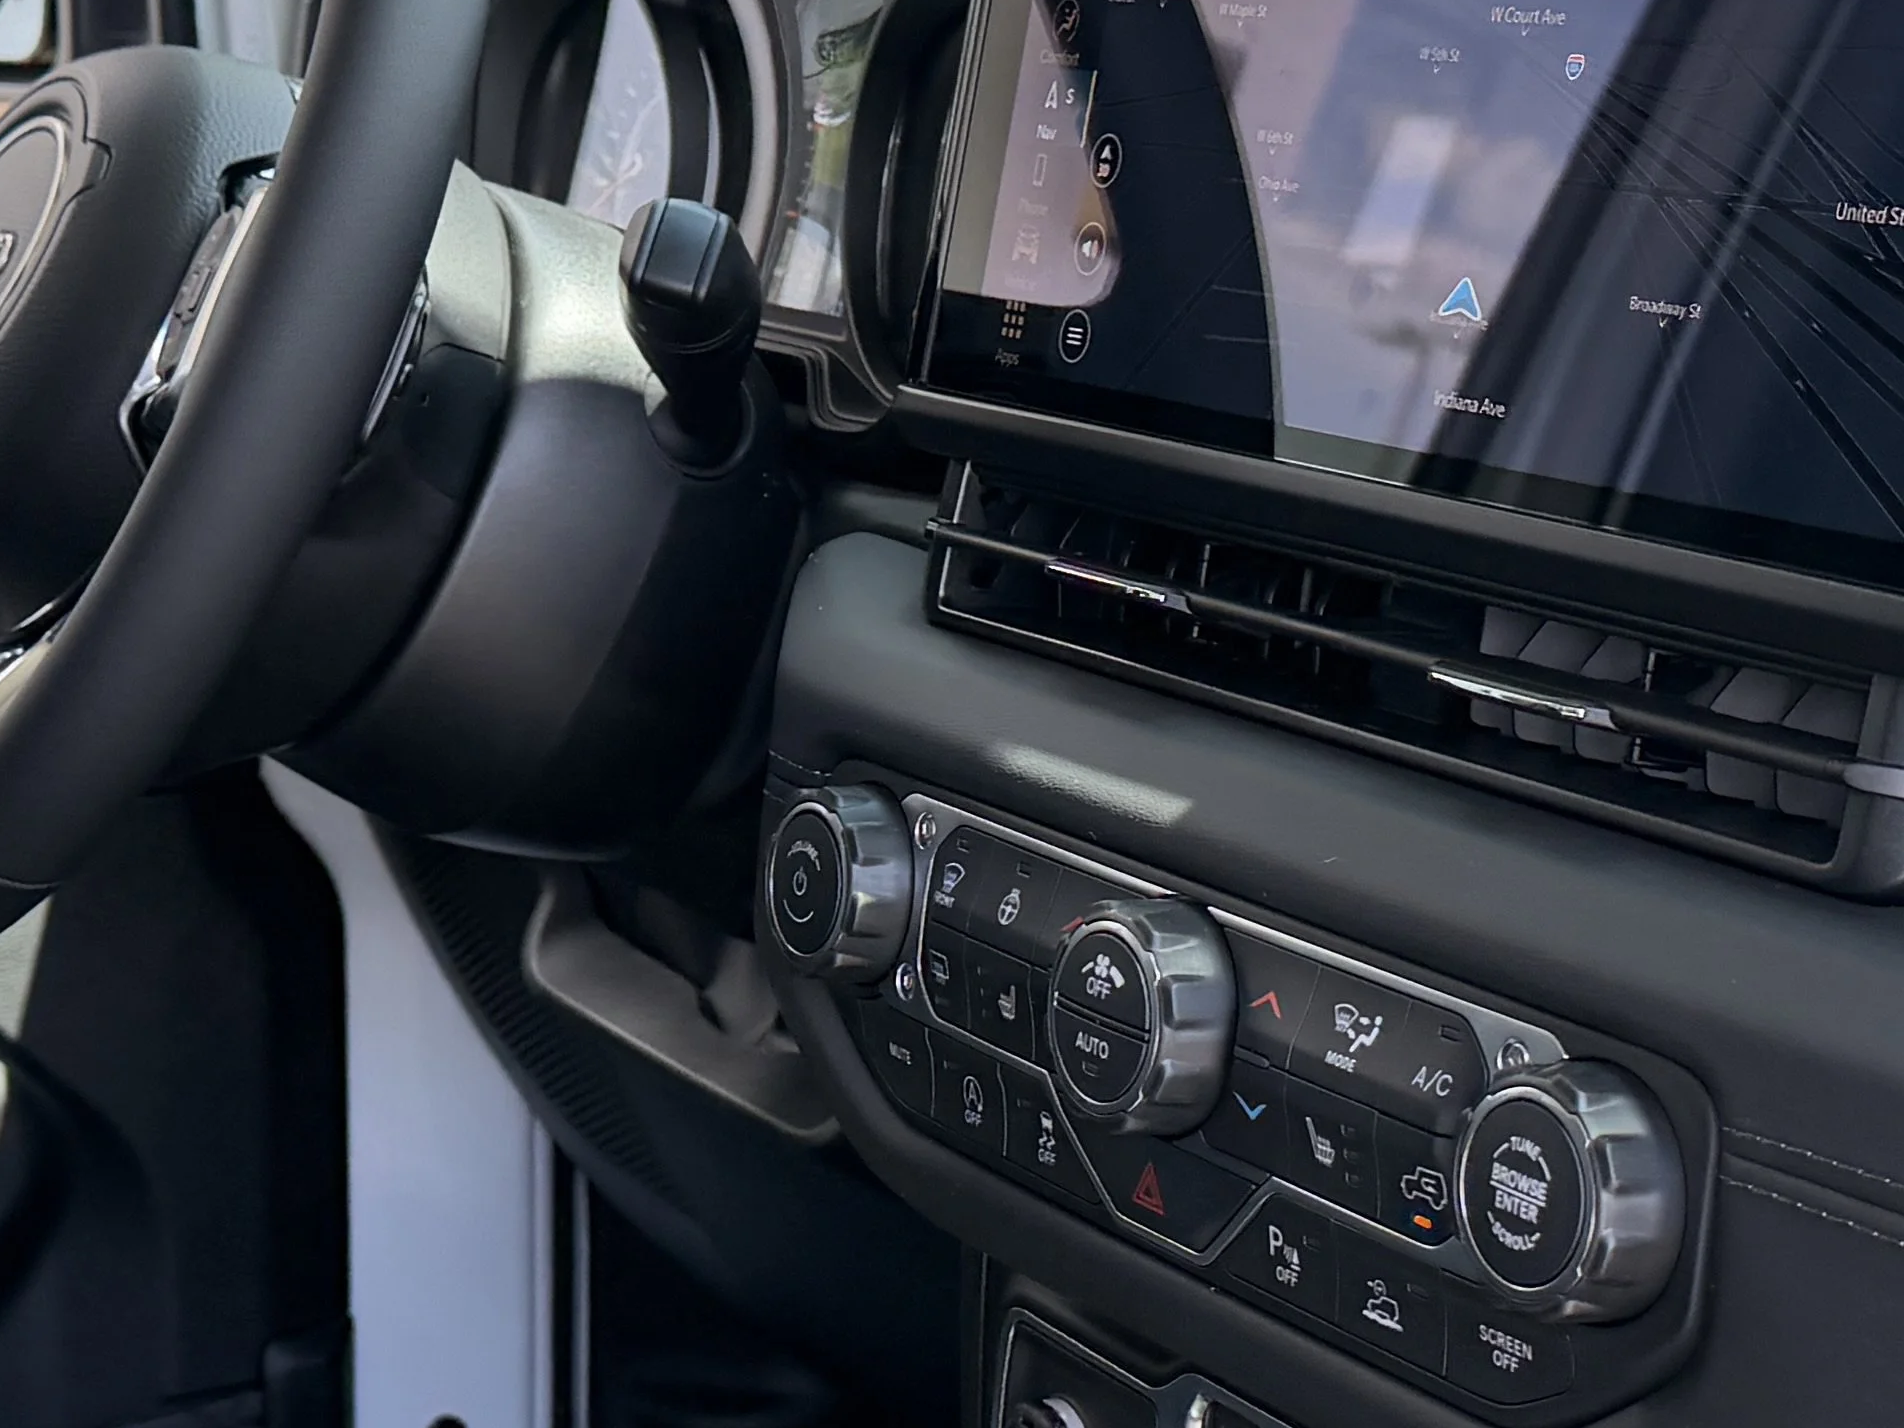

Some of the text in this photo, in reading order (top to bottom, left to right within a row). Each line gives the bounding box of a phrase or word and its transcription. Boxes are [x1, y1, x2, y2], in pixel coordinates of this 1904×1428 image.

[1490, 7, 1566, 25] W Court Ave
[1036, 123, 1058, 141] Nav
[1835, 202, 1889, 226] United
[1629, 295, 1702, 320] Broadway St
[1433, 389, 1506, 420] Indiana Ave
[1085, 975, 1112, 1001] OFF
[1075, 1030, 1109, 1060] AUTO
[1324, 1049, 1357, 1073] MODE
[1412, 1064, 1454, 1098] A/C
[964, 1109, 984, 1128] OFF
[1510, 1136, 1542, 1162] TUNE
[1491, 1161, 1548, 1202] BROWSE
[1494, 1189, 1539, 1224] ENTER
[1491, 1221, 1536, 1251] SCROLL
[1275, 1265, 1300, 1288] OFF
[1479, 1324, 1533, 1362] SCREEN
[1492, 1348, 1520, 1374] OFF
